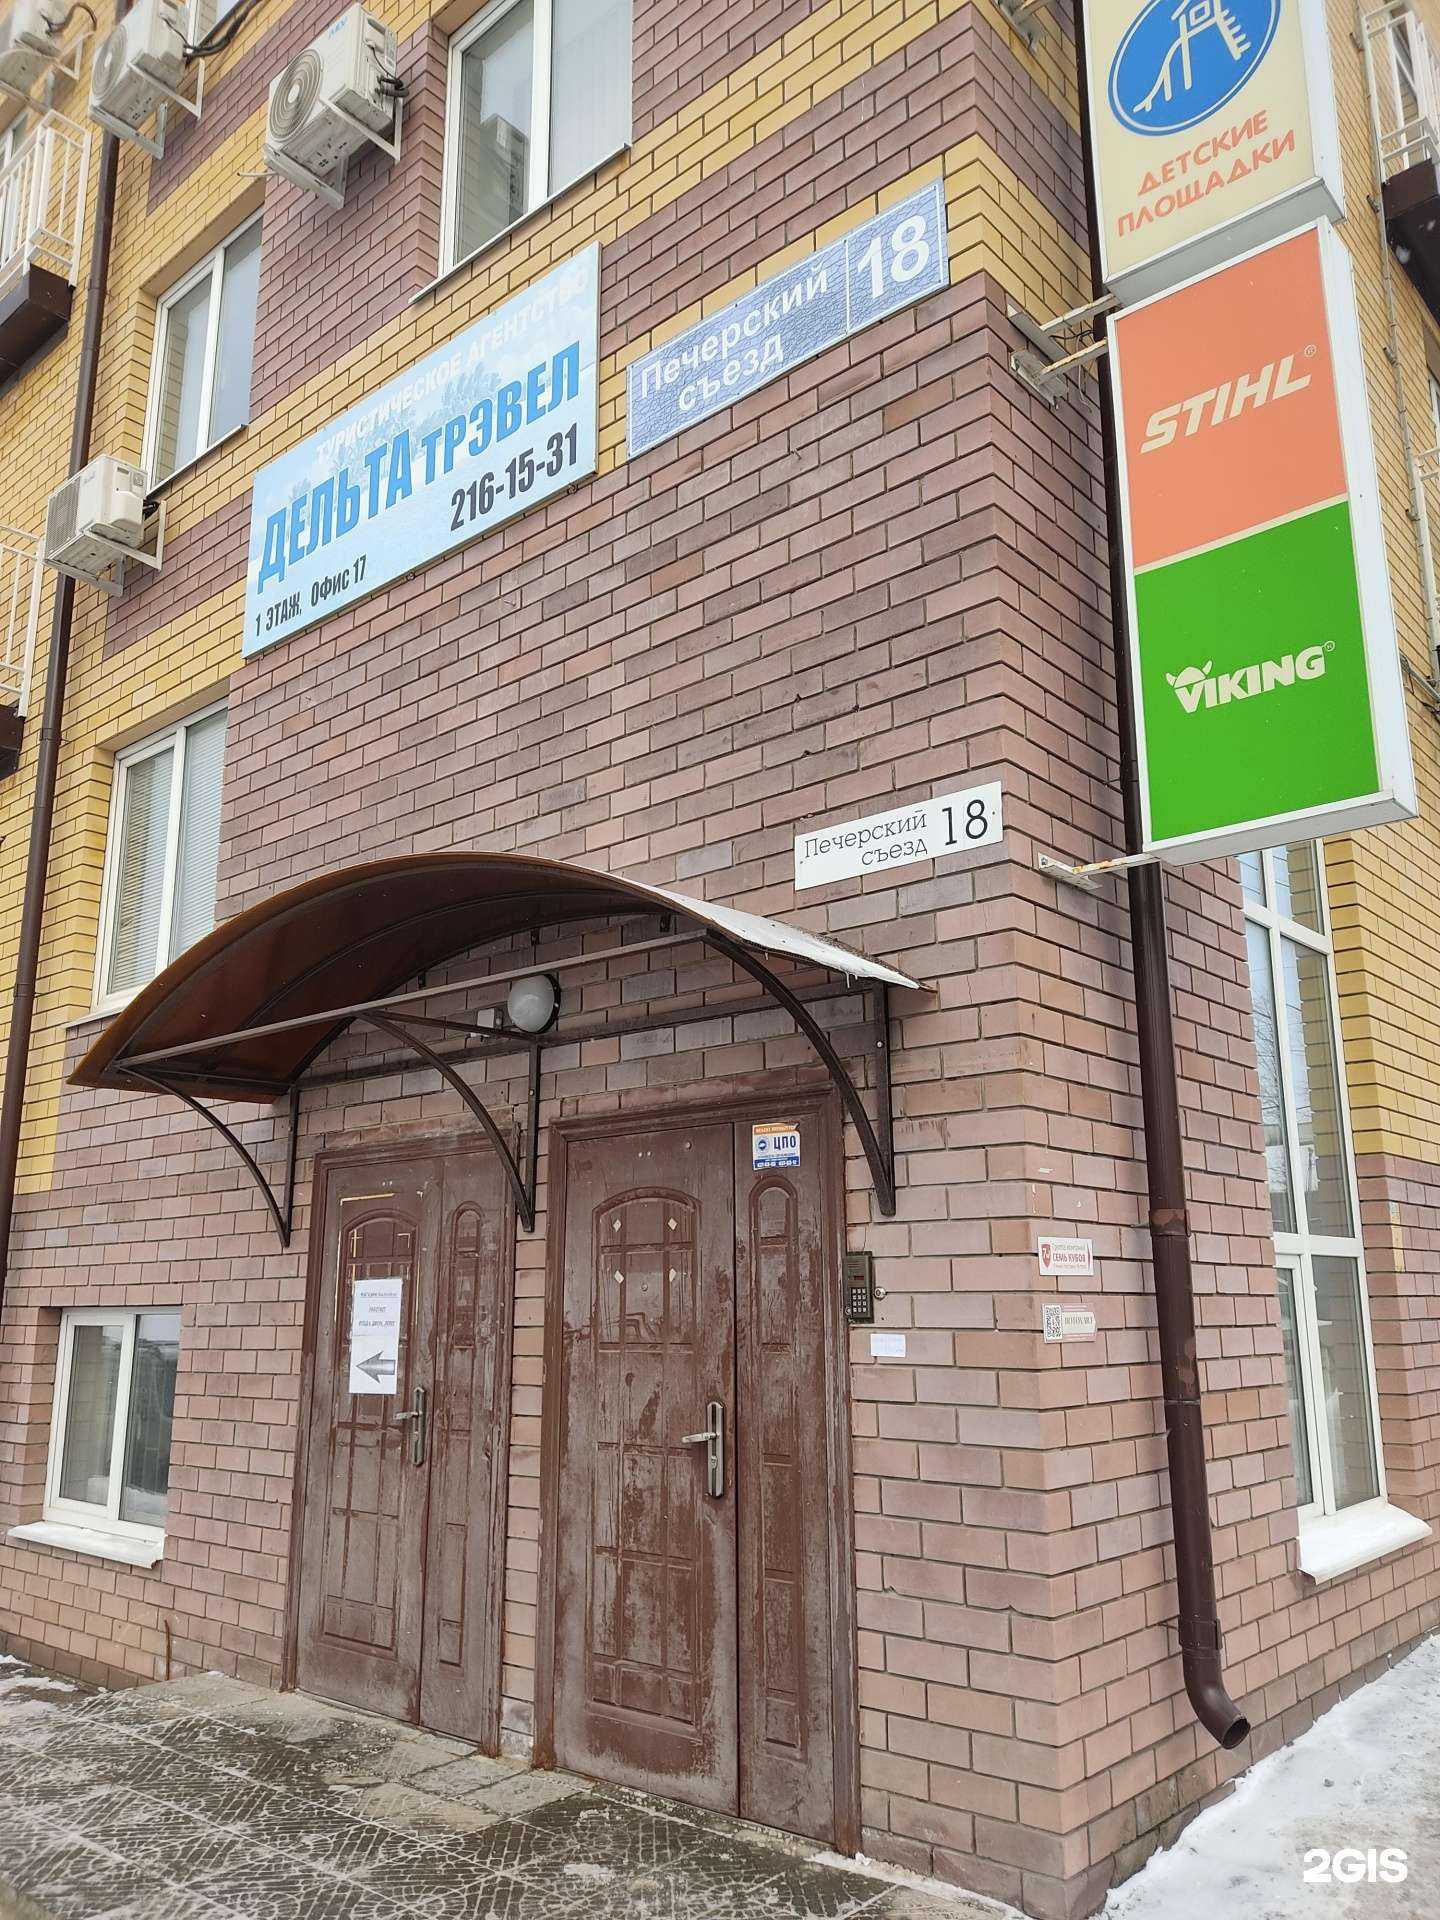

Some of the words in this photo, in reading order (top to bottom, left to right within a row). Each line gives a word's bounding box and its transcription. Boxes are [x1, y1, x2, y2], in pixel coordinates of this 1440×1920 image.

[1117, 128, 1295, 237] ПЛОЩАДКИ
[1137, 109, 1268, 196] ДЕТСКИЕ
[857, 215, 930, 299] 18
[316, 351, 462, 462] ТУРИСТИЧЕСКОЕ
[467, 266, 589, 366] АГЕНТСТО
[641, 264, 828, 400] Печерский
[678, 333, 784, 412] съезд
[1139, 353, 1312, 455] STIHL
[450, 422, 578, 532] 216-15-31
[255, 613, 262, 637] 1
[310, 568, 350, 607] ОФИС
[352, 554, 367, 584] 17
[1174, 645, 1327, 714] VIKING
[804, 808, 927, 859] Печерский
[861, 838, 928, 866] съезд
[942, 799, 988, 846] 18
[773, 1135, 797, 1150] ЦПО
